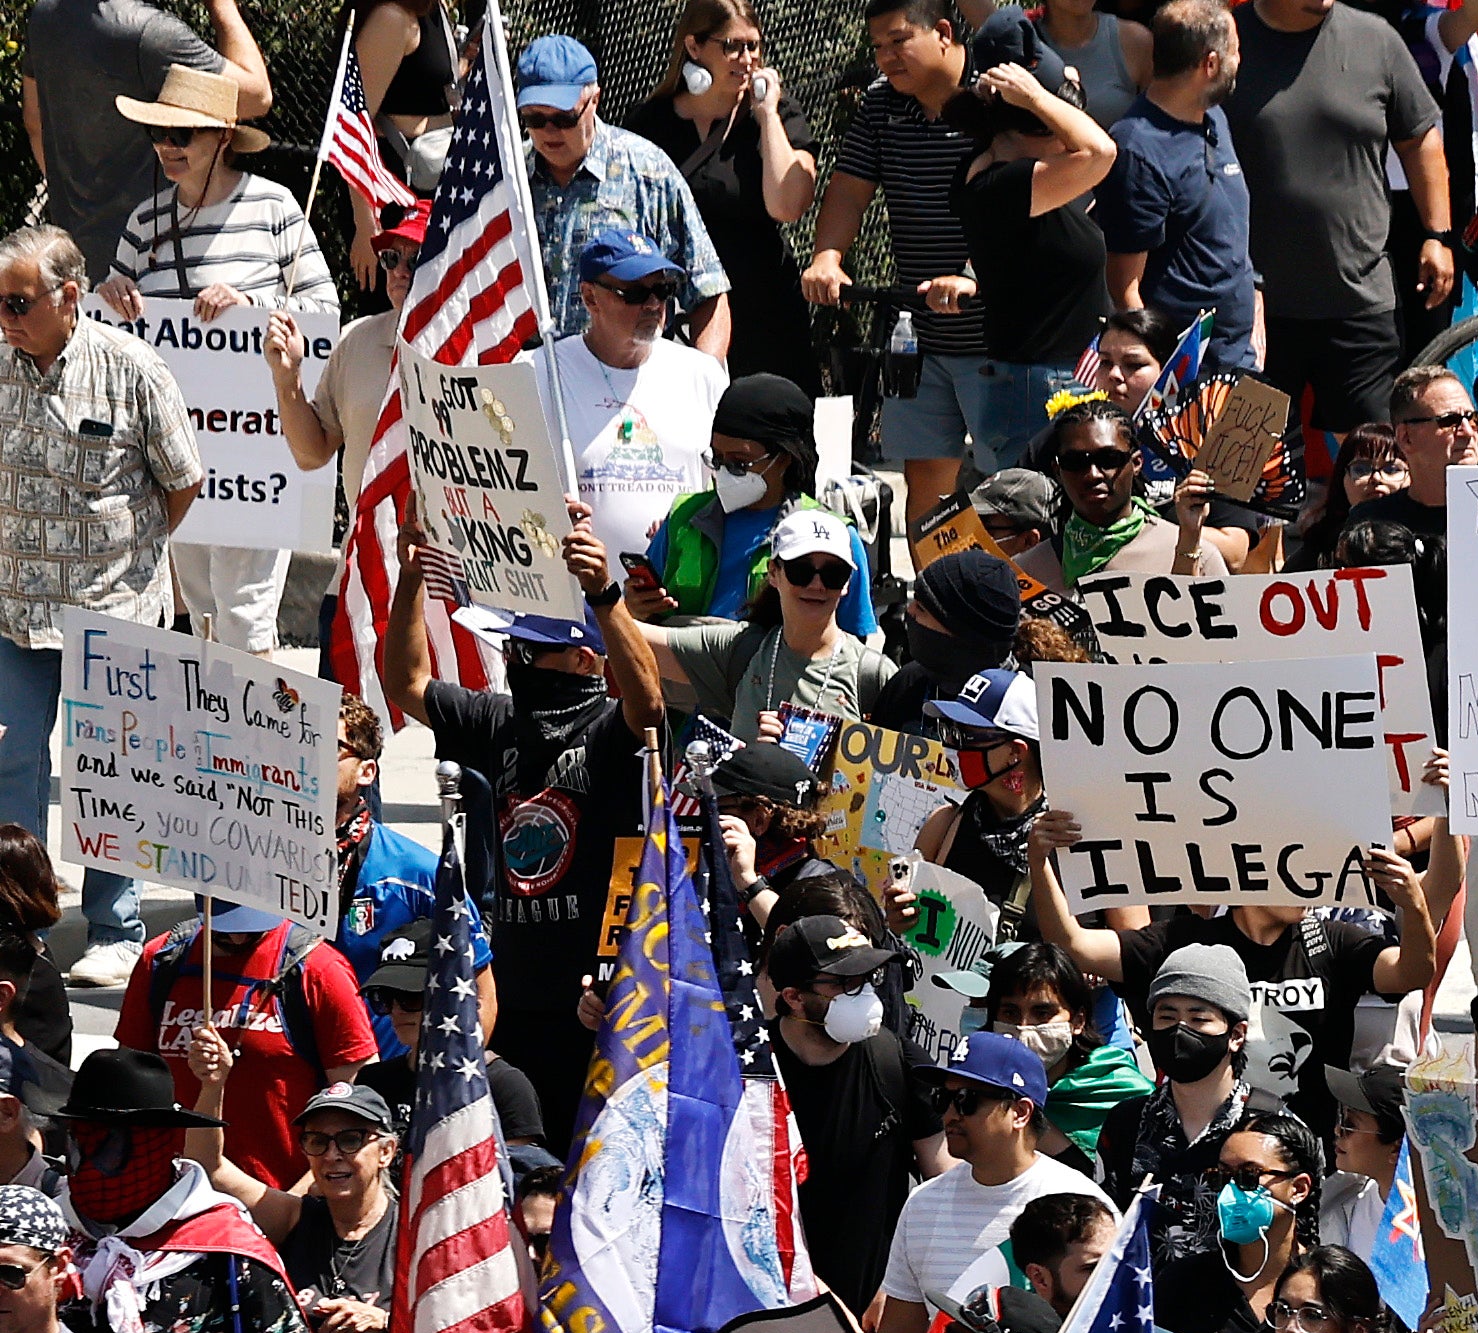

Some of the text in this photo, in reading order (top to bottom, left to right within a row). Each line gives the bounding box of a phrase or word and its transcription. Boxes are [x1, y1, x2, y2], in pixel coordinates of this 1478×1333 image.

[409, 424, 538, 493] PROBLEMZ
[1078, 569, 1388, 640] ICE OUT
[1050, 688, 1378, 759] NO ONE
[1125, 770, 1238, 824] IS
